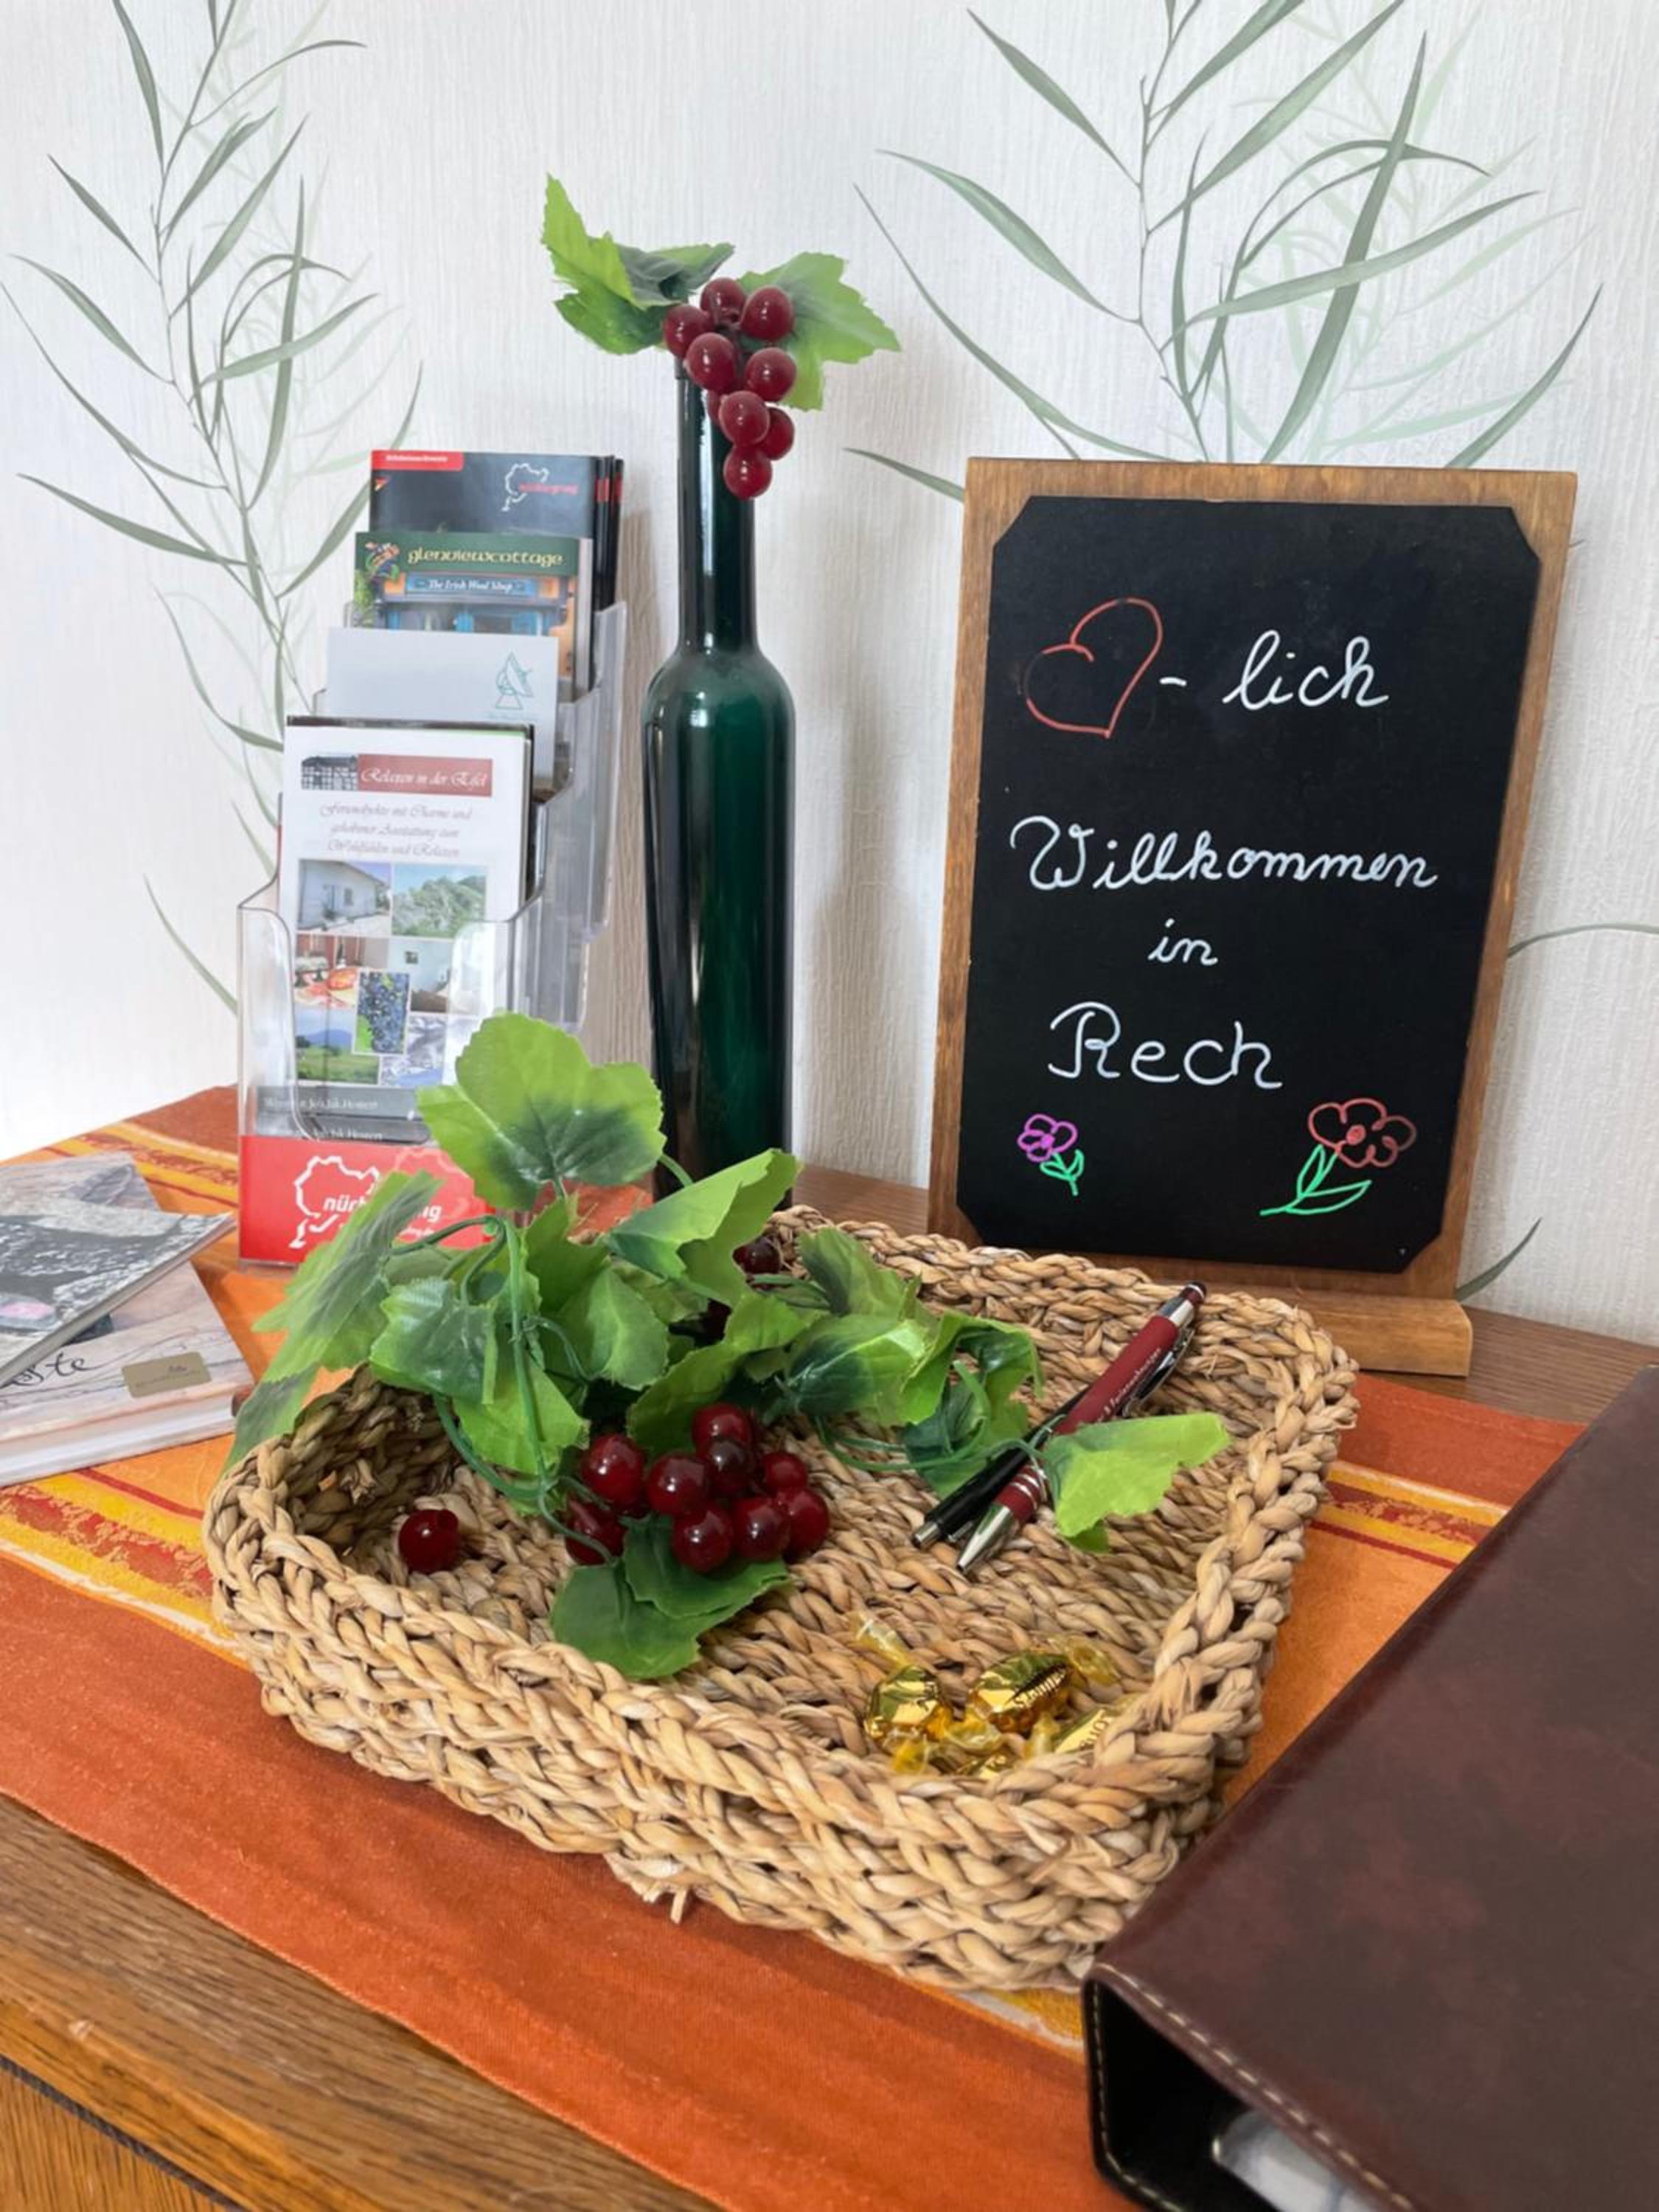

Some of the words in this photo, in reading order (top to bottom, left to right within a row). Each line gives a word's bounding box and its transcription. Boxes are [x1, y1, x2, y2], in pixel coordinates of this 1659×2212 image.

[1009, 815, 1438, 891] Willkommen
[1147, 918, 1218, 965] in
[1047, 1000, 1283, 1090] Rech
